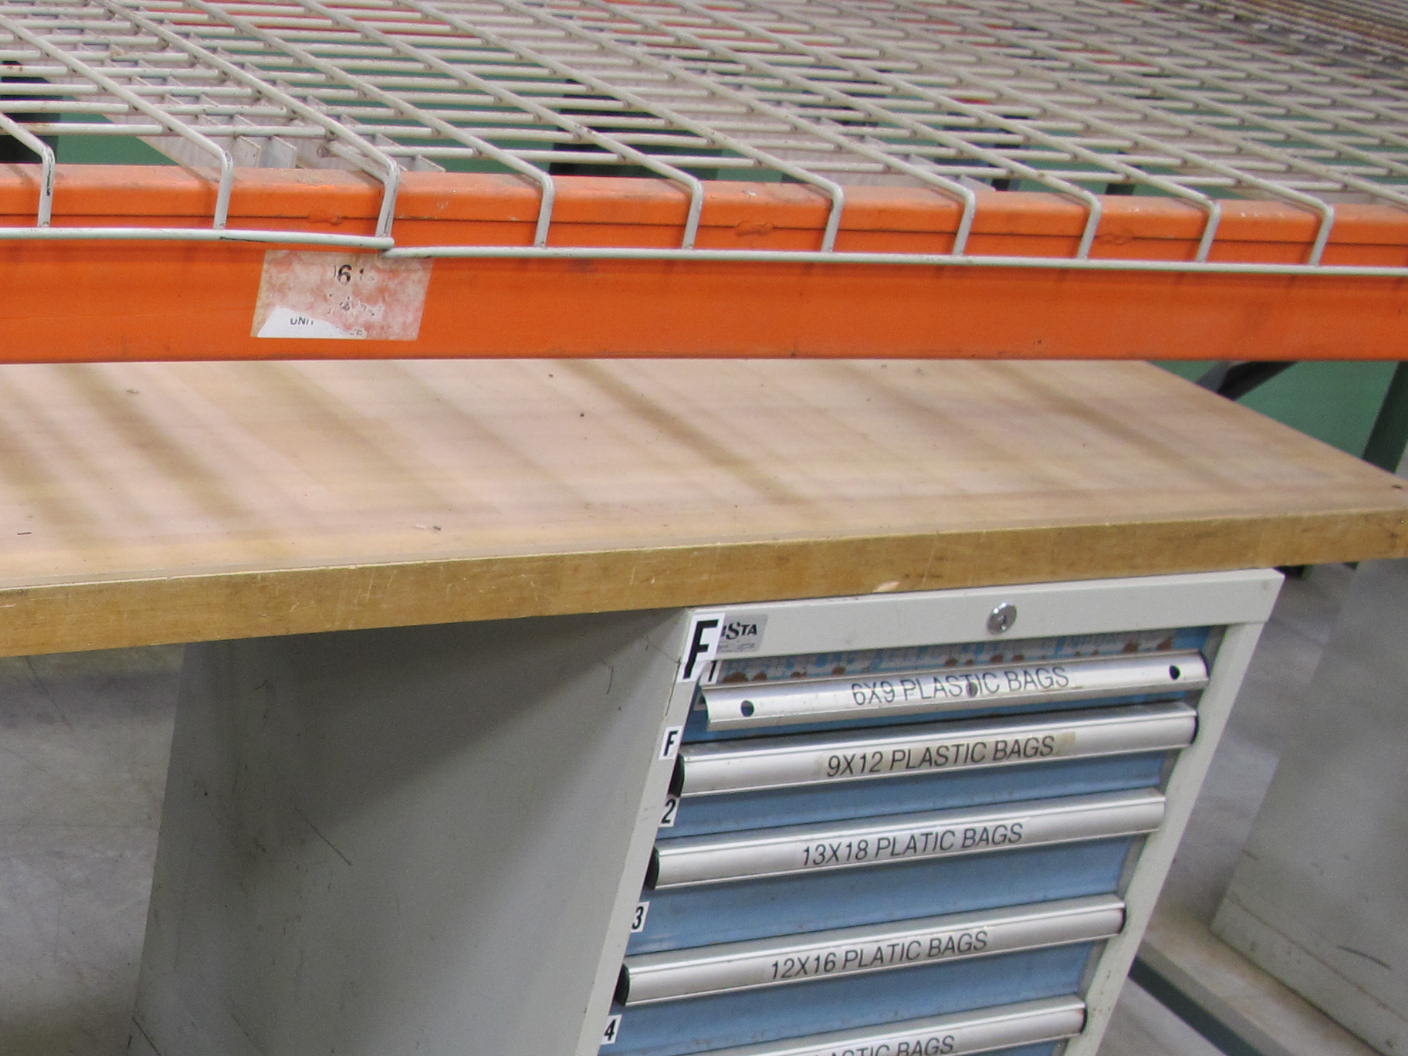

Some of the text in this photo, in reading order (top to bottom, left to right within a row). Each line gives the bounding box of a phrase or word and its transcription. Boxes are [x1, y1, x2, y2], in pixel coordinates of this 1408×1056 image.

[720, 621, 758, 640] ISTA
[683, 619, 719, 680] F
[850, 666, 1070, 706] 6X9 PLASTIC BAGS
[663, 730, 679, 757] F
[826, 735, 1055, 777] 9X12 PLASTIC BAGS
[661, 799, 677, 824] 2
[802, 823, 1024, 866] 13X18 PLATIC BAGS
[631, 906, 644, 930] 3
[770, 931, 989, 980] 12X16 PLATIC BAGS
[603, 1019, 616, 1042] 4
